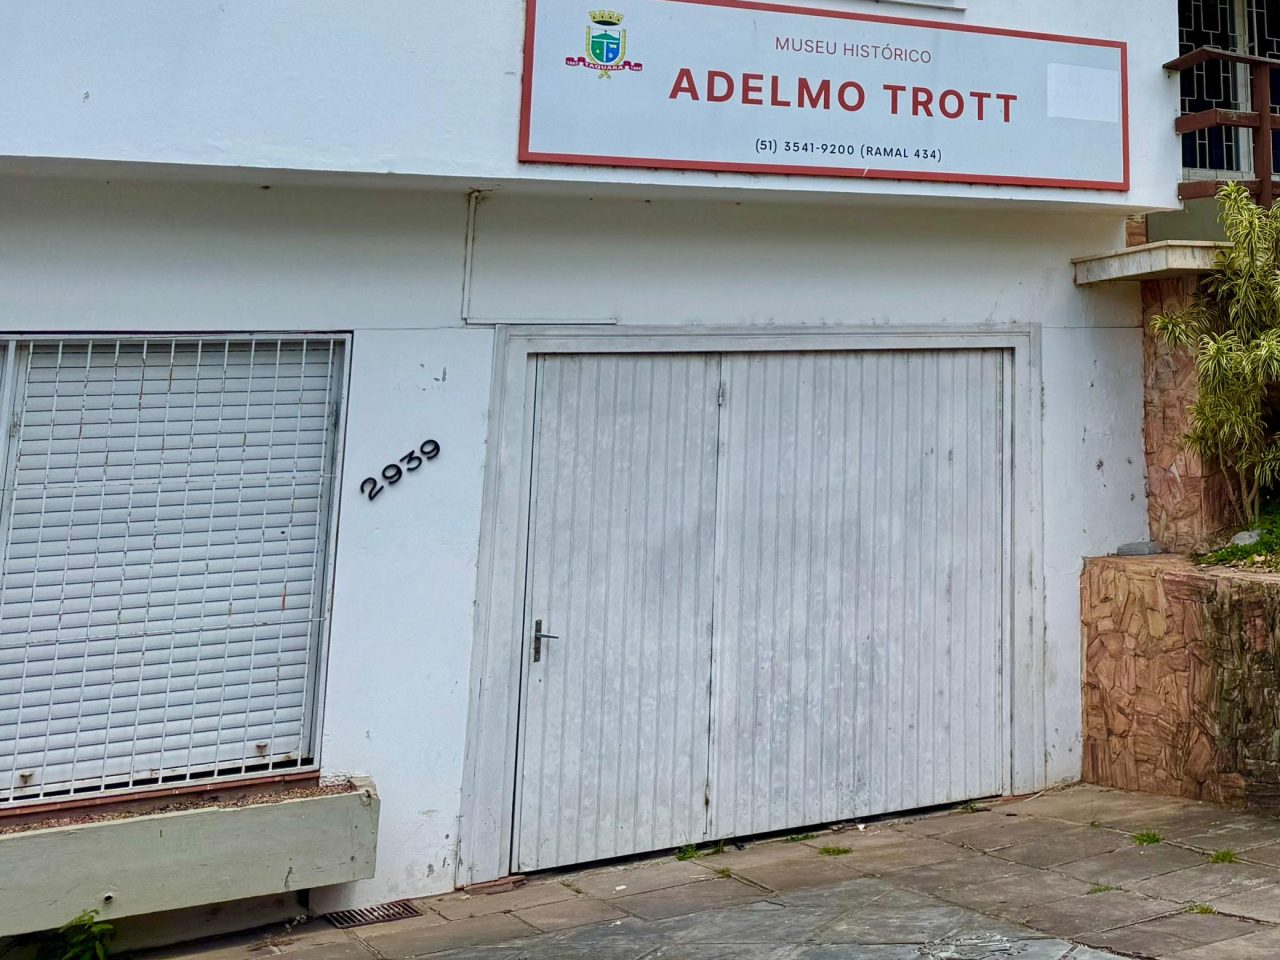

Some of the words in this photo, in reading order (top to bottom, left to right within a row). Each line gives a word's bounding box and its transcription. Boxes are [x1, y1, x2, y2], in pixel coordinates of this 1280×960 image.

[775, 36, 837, 55] MUSEU
[843, 42, 932, 64] HISTÓRICO
[584, 61, 625, 71] TAQUARA
[669, 67, 865, 113] ADELMO
[882, 84, 1018, 123] TROTT
[755, 138, 778, 155] (51)
[784, 141, 855, 156] 3541-9200
[860, 144, 910, 160] (RAMAL
[913, 148, 942, 163] 434)
[360, 439, 441, 501] 2939
